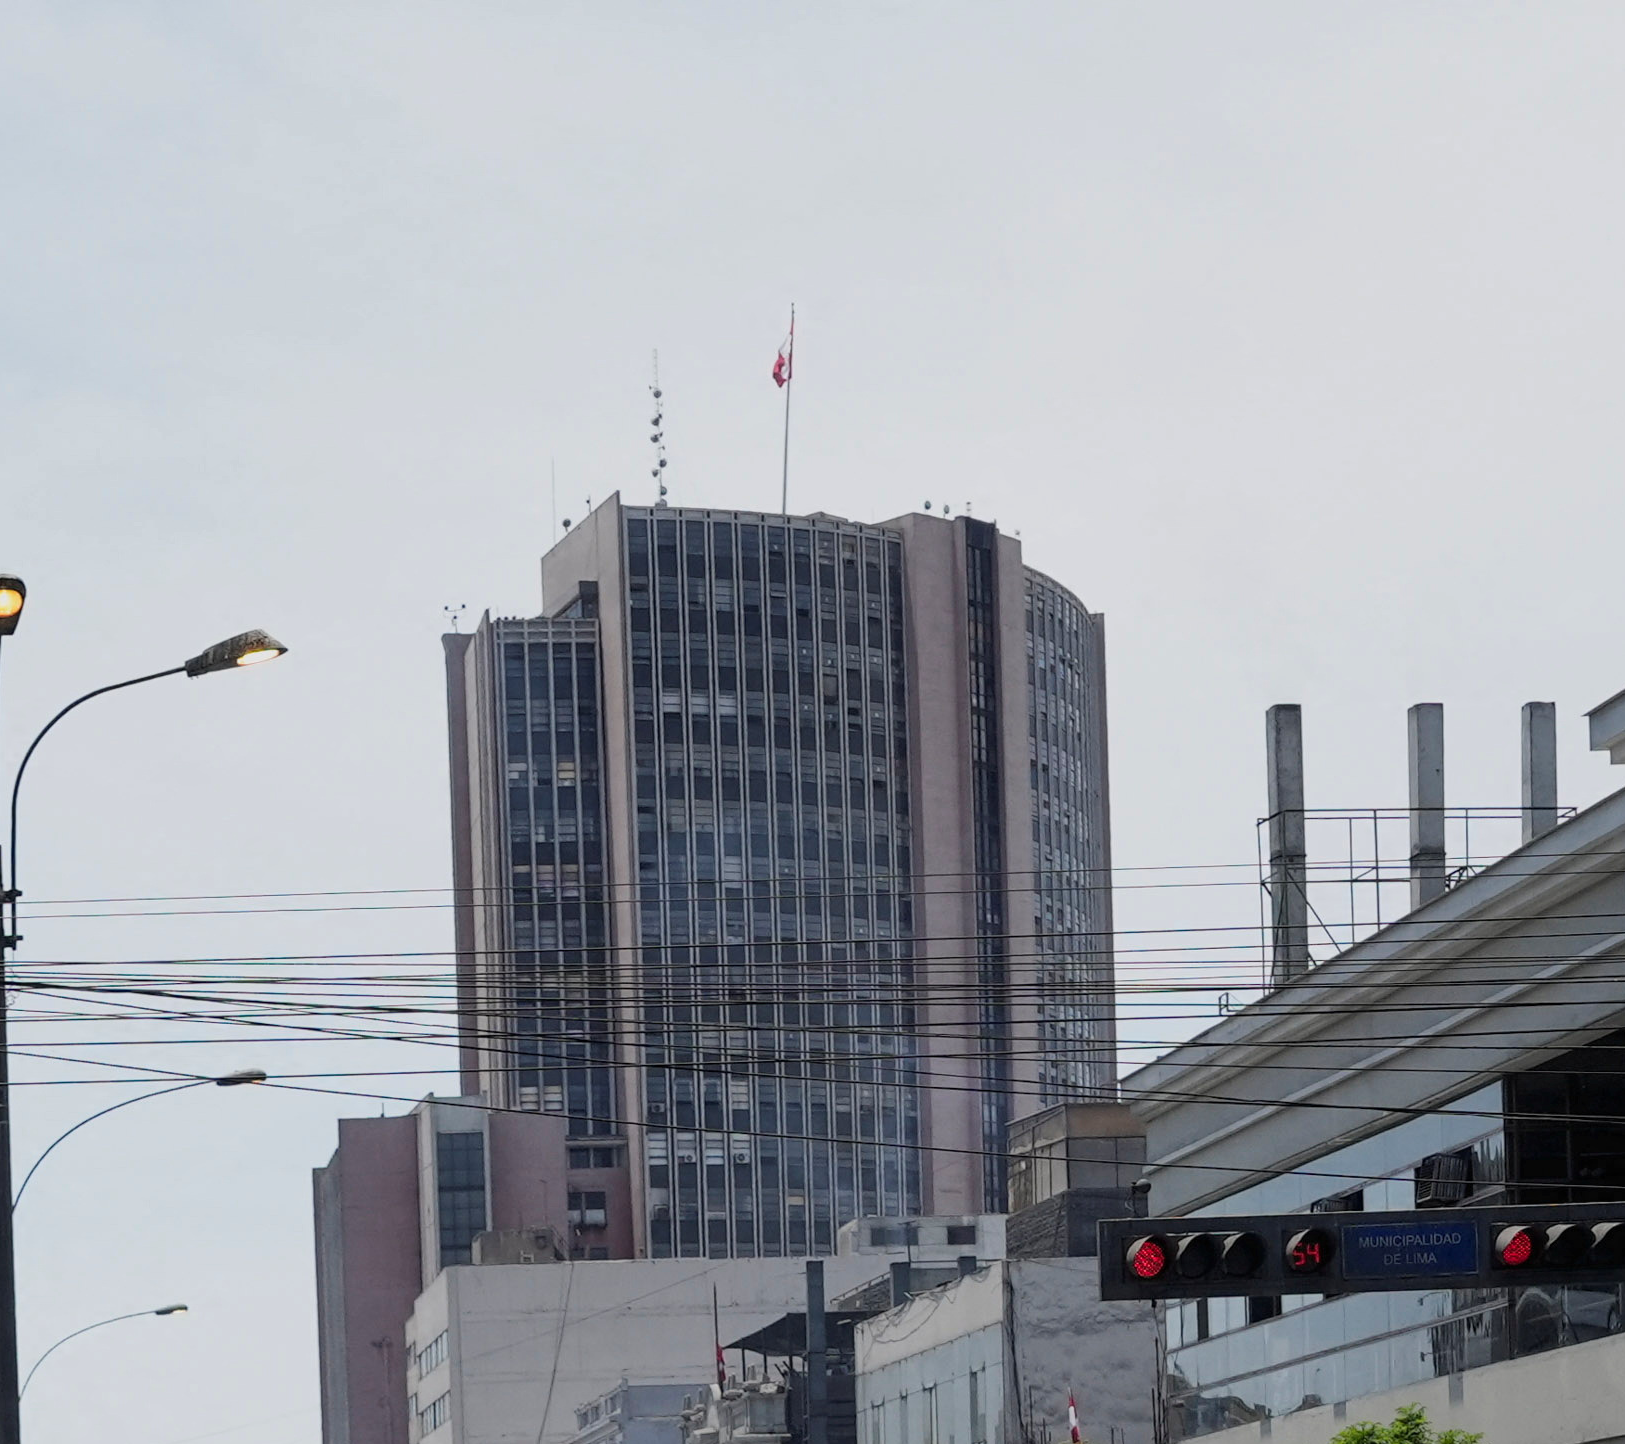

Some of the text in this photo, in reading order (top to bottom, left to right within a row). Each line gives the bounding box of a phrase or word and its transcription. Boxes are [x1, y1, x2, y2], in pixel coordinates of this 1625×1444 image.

[1358, 1232, 1462, 1248] MUNICIPALIDAD
[1292, 1240, 1320, 1265] 54
[1383, 1251, 1438, 1266] DE LIMA
